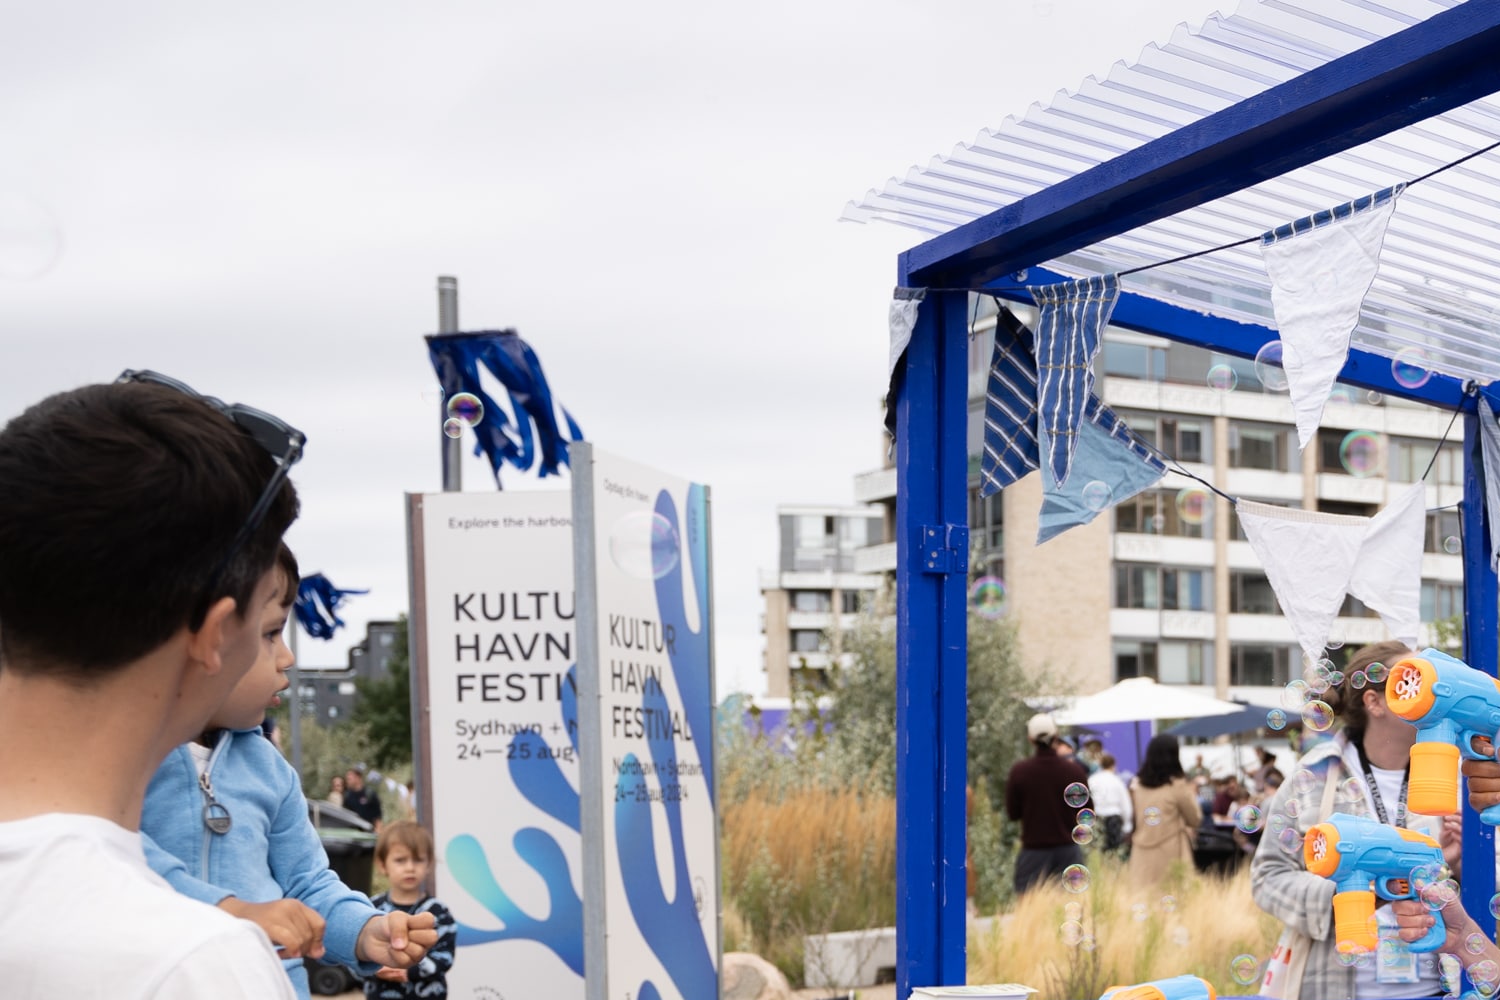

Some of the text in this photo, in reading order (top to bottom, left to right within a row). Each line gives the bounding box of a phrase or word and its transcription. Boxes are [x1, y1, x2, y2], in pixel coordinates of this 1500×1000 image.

[448, 517, 499, 531] Explore
[503, 517, 524, 528] the
[454, 592, 576, 621] KULTU
[456, 632, 571, 662] HAVN
[609, 613, 677, 656] KULTUR
[611, 659, 663, 697] HAVN
[455, 719, 543, 741] Sydhavn
[613, 706, 692, 741] FESTIVAL
[537, 746, 575, 763] aug
